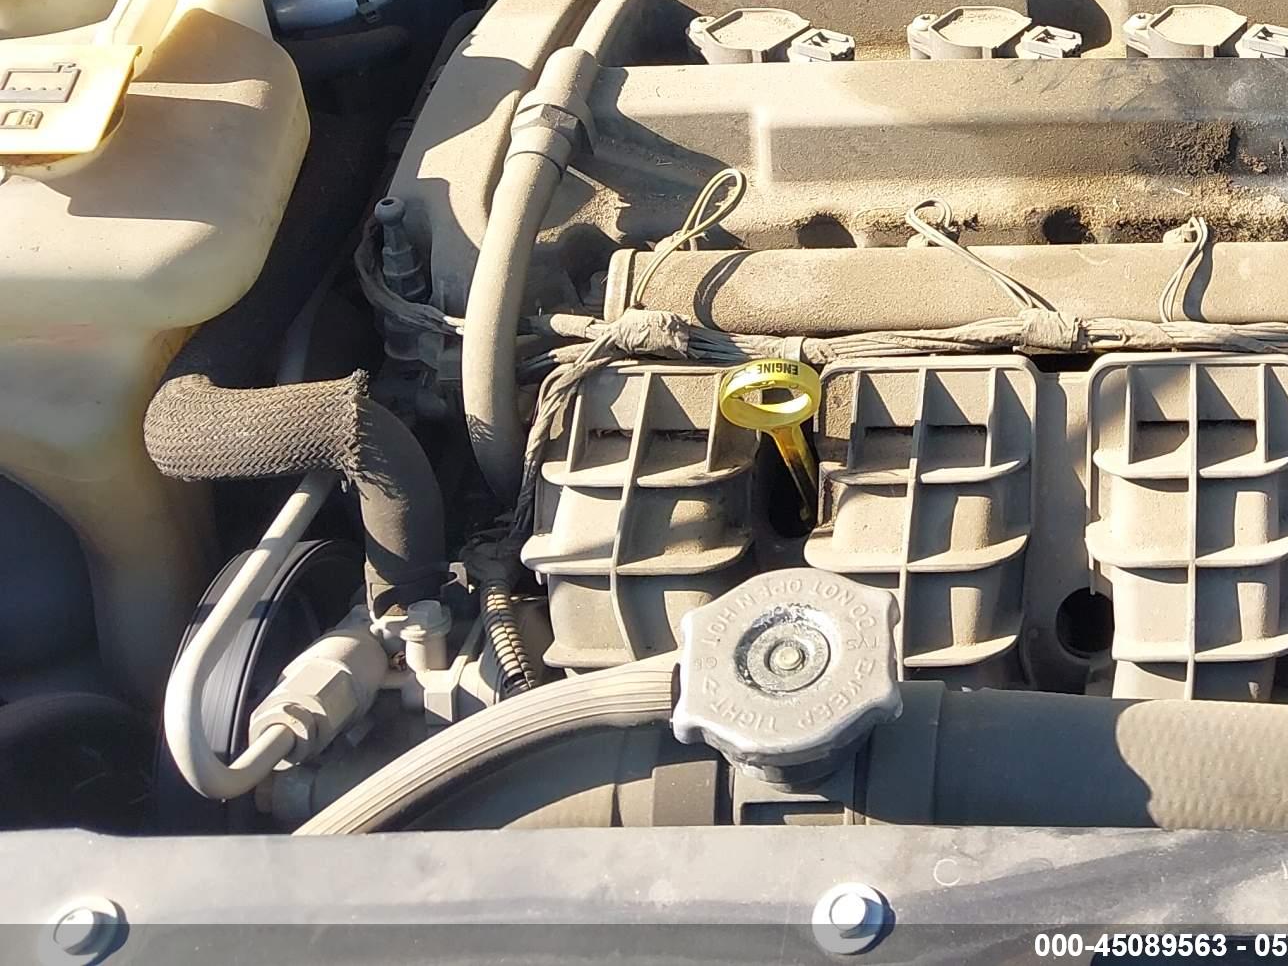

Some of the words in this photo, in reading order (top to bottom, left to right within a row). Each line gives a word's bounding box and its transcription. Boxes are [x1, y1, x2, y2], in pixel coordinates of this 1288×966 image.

[758, 362, 799, 375] ENGINE
[811, 579, 855, 608] NOT
[702, 605, 738, 648] HOT
[708, 694, 779, 732] TIGHT
[799, 677, 865, 729] KEEP
